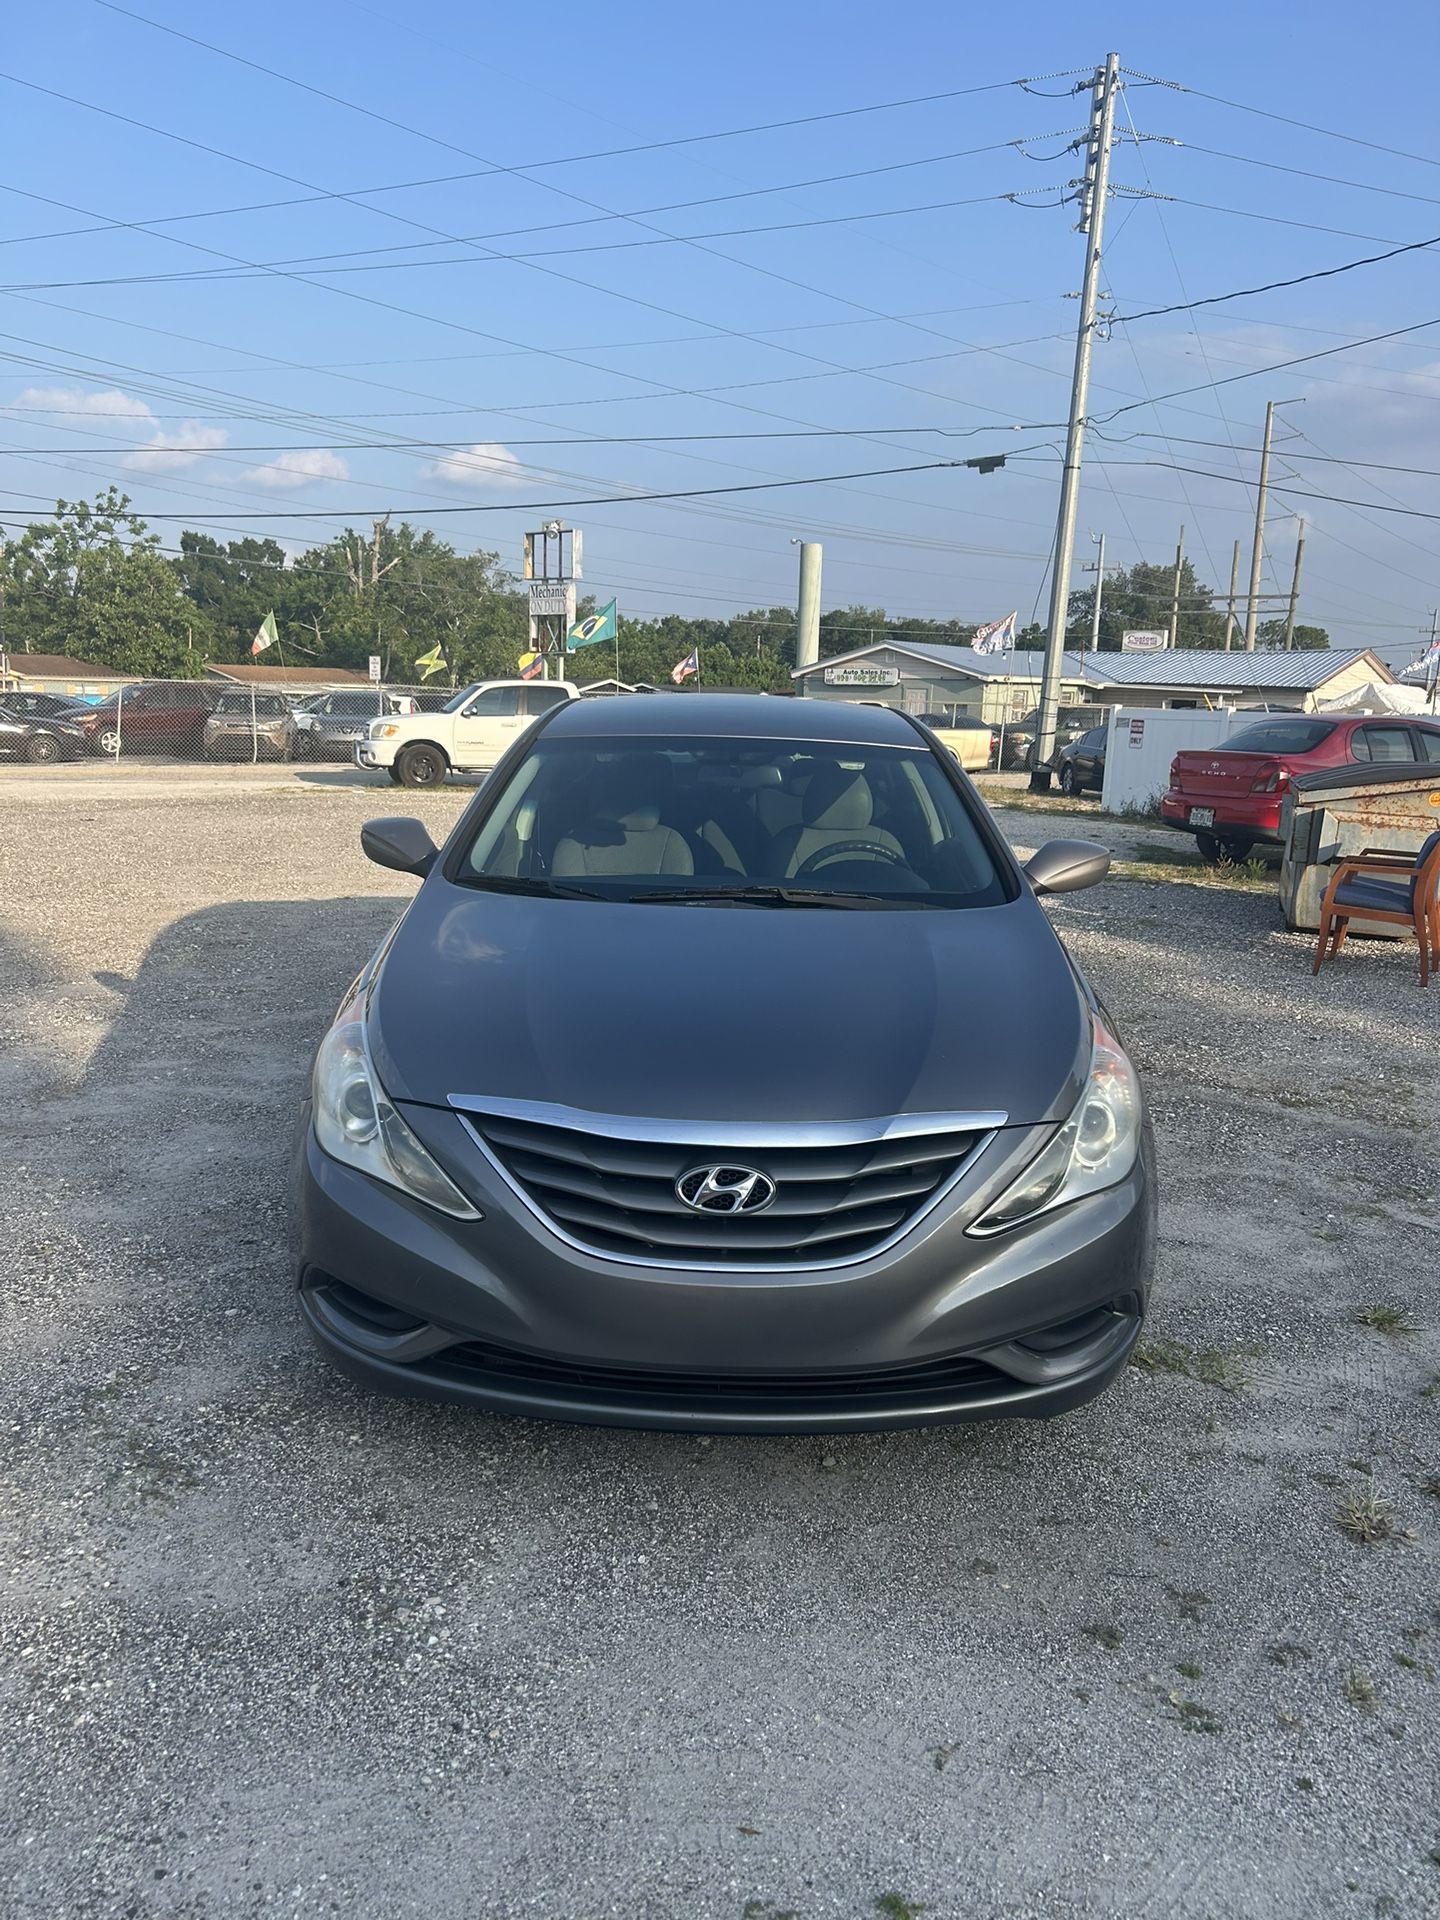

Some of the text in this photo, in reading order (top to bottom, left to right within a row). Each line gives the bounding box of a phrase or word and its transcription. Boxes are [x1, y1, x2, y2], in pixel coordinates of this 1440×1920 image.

[530, 584, 567, 598] Mechanic
[530, 600, 566, 613] ON DUTY
